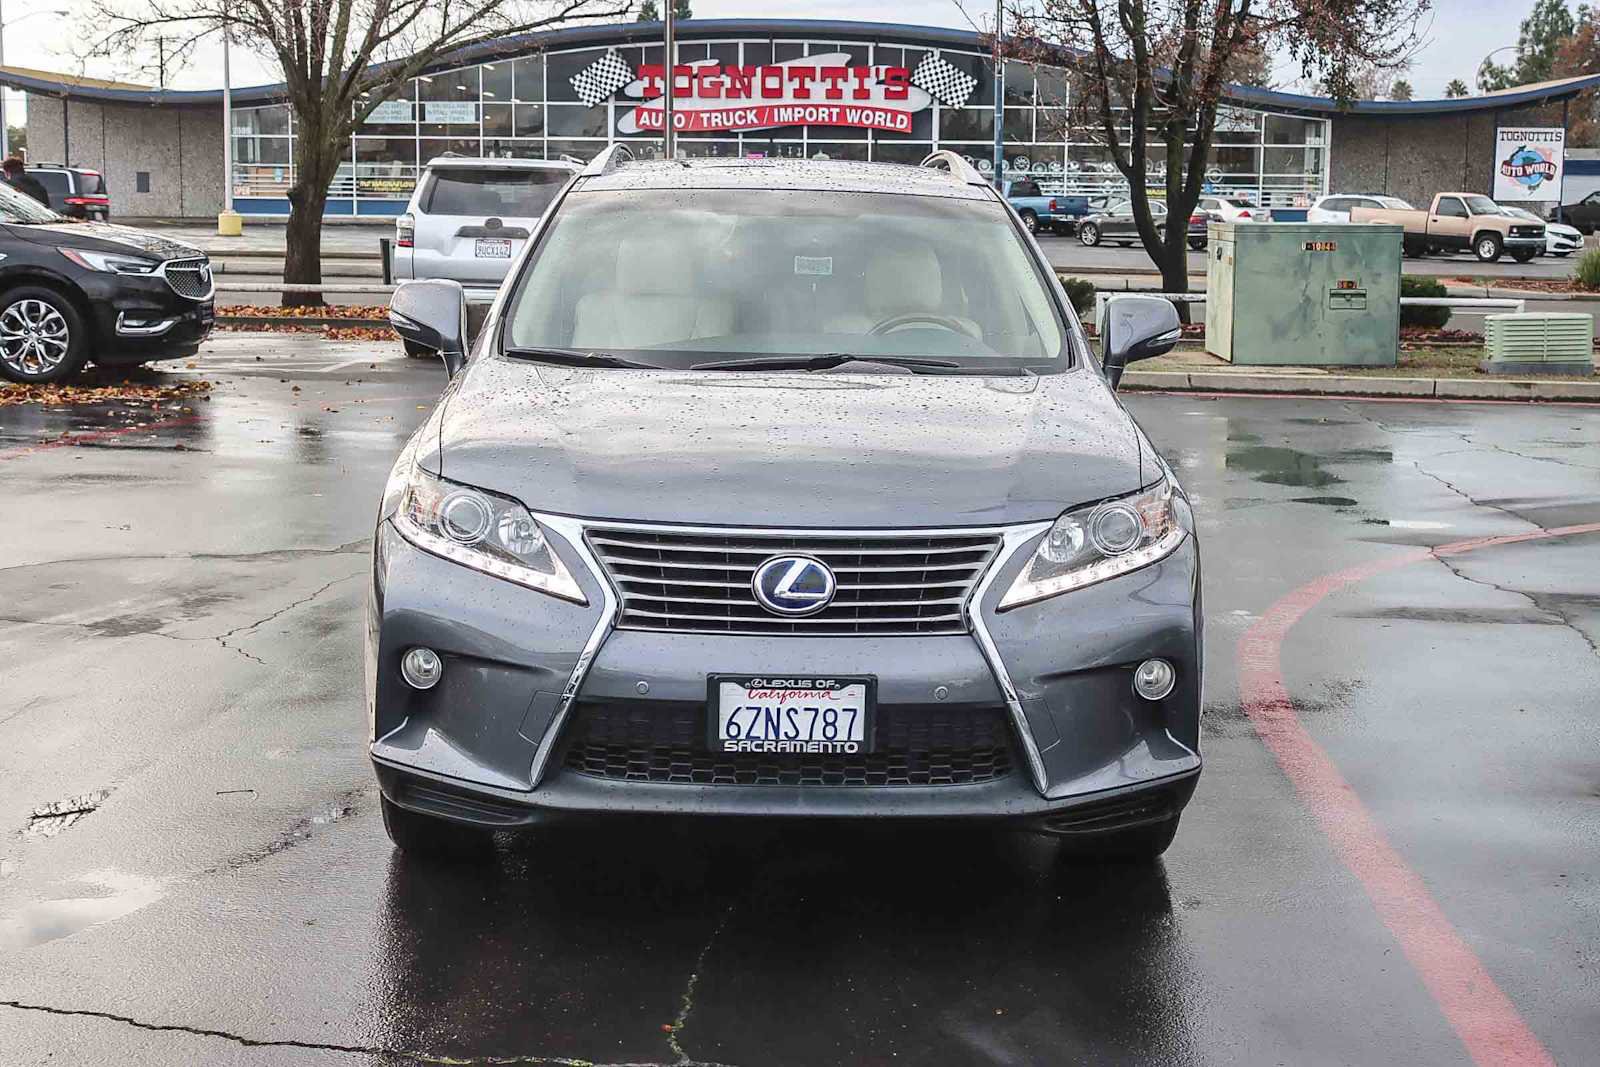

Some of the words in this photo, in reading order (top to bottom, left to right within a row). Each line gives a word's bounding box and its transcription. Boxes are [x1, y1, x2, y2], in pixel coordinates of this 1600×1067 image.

[637, 64, 910, 100] TOGNOTTI'S
[639, 111, 686, 127] AUO
[700, 109, 759, 128] TRUCK
[773, 107, 840, 123] IMPORT
[846, 108, 908, 129] WORLD
[1502, 163, 1523, 177] AUTO
[1525, 162, 1555, 176] WORLD
[763, 679, 812, 689] LEXUS
[816, 679, 835, 689] OF
[747, 688, 840, 705] California
[725, 706, 858, 741] 6ZNS787
[724, 740, 859, 753] SACRAMENTO
